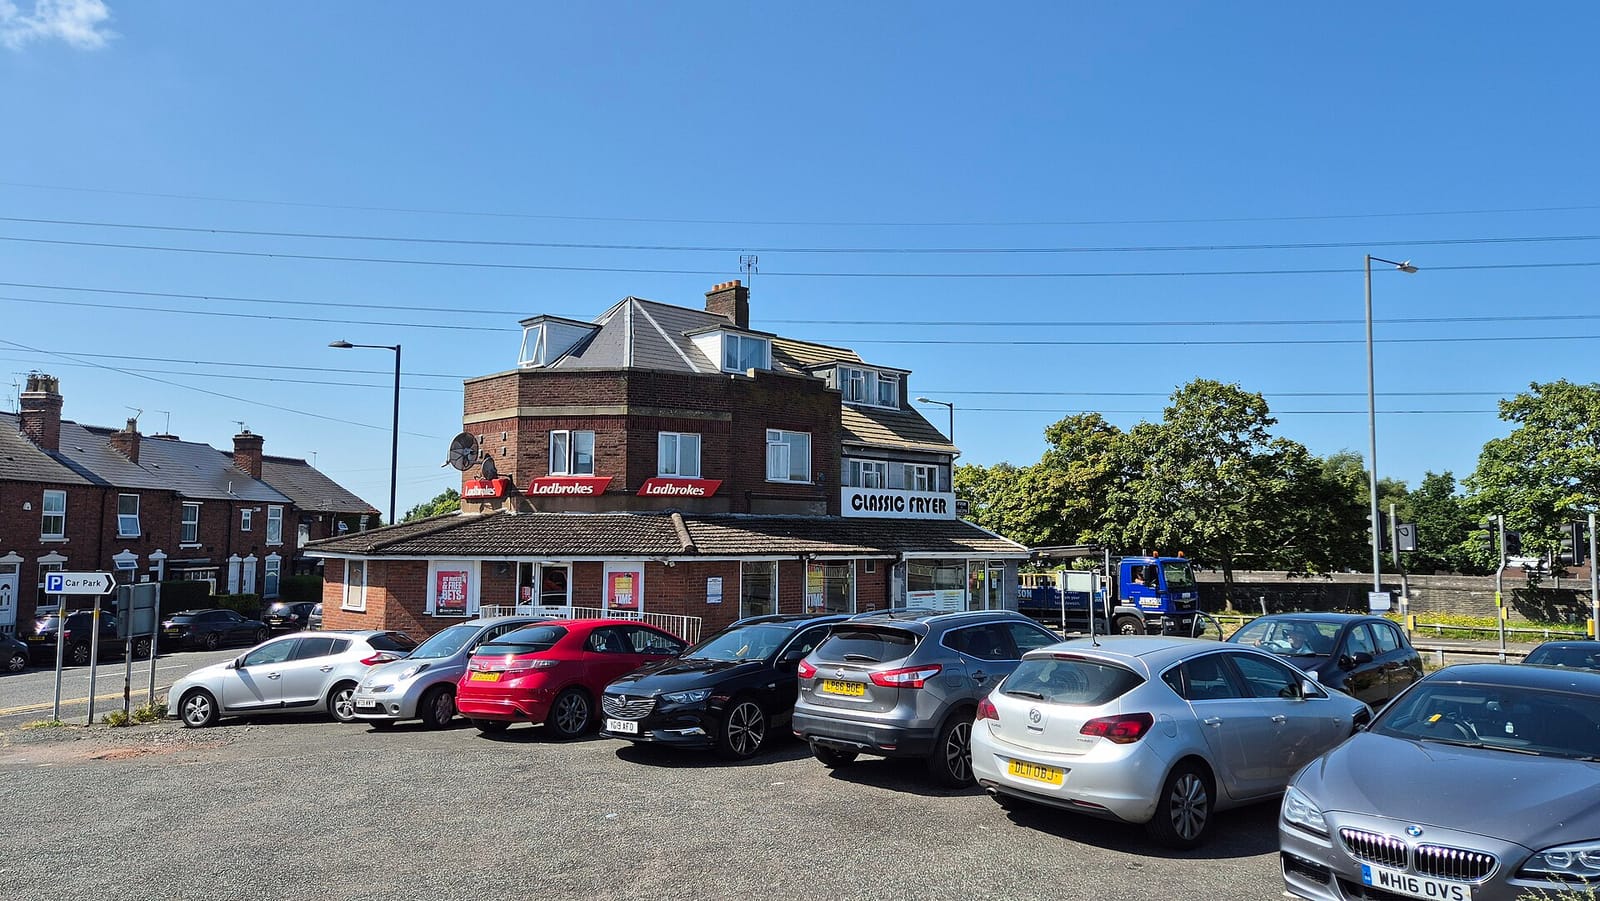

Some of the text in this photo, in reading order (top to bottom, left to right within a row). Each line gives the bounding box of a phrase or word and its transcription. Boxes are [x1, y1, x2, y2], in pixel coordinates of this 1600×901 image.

[533, 483, 594, 495] Ladbrokes
[646, 483, 705, 496] Ladbrokes
[851, 493, 905, 513] CLASSIC
[908, 496, 947, 514] FRYER
[51, 576, 101, 590] P Car Park
[448, 581, 462, 590] FREE
[615, 593, 632, 605] TIME
[1033, 763, 1054, 781] OBJ
[1378, 870, 1463, 901] WH16 OVS
